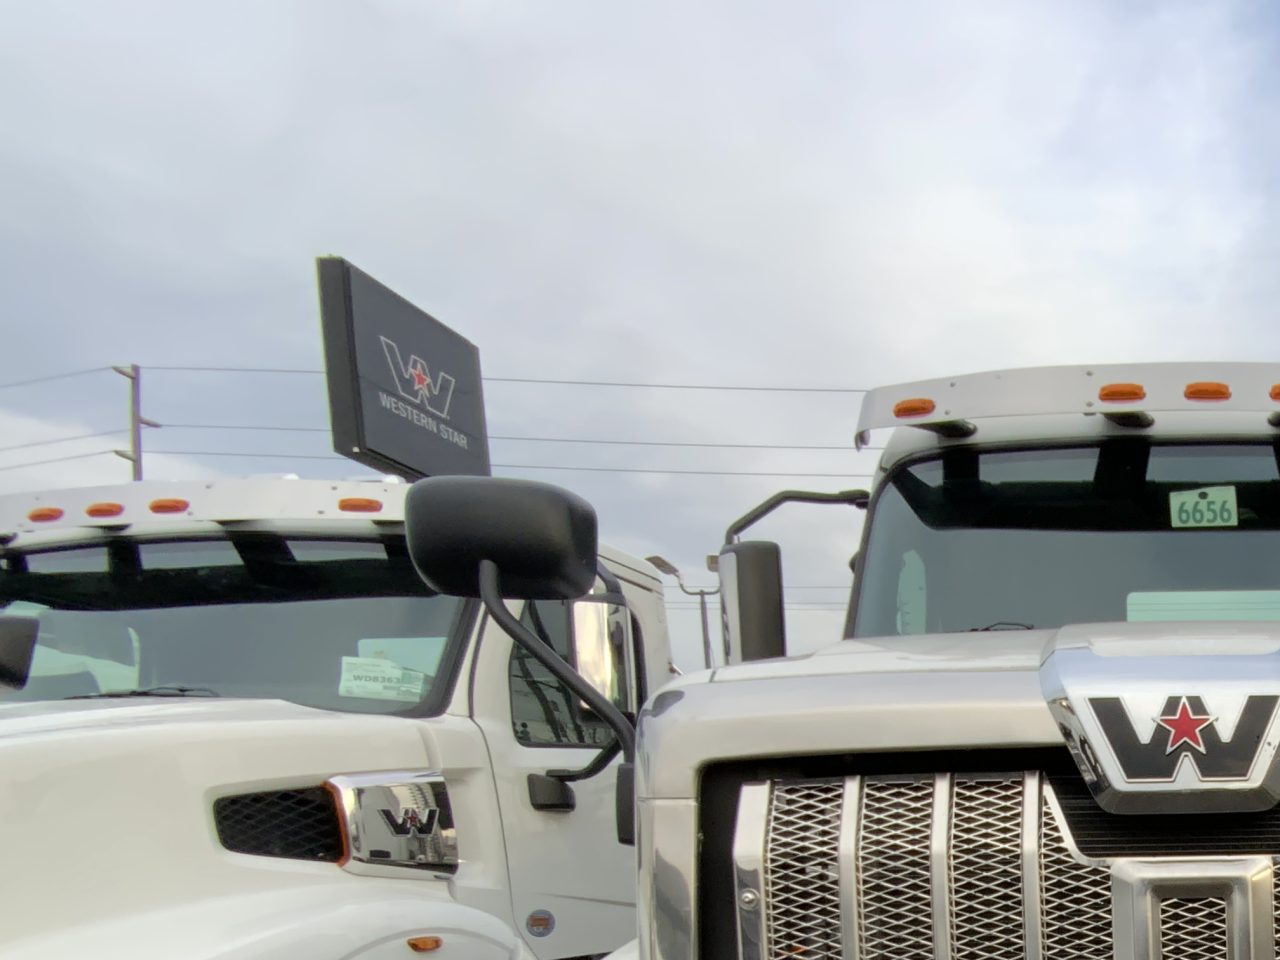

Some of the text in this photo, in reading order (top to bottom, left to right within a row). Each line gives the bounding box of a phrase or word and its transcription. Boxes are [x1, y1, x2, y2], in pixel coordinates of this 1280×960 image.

[379, 391, 468, 450] WESTERN STAR
[1178, 501, 1232, 524] 6656
